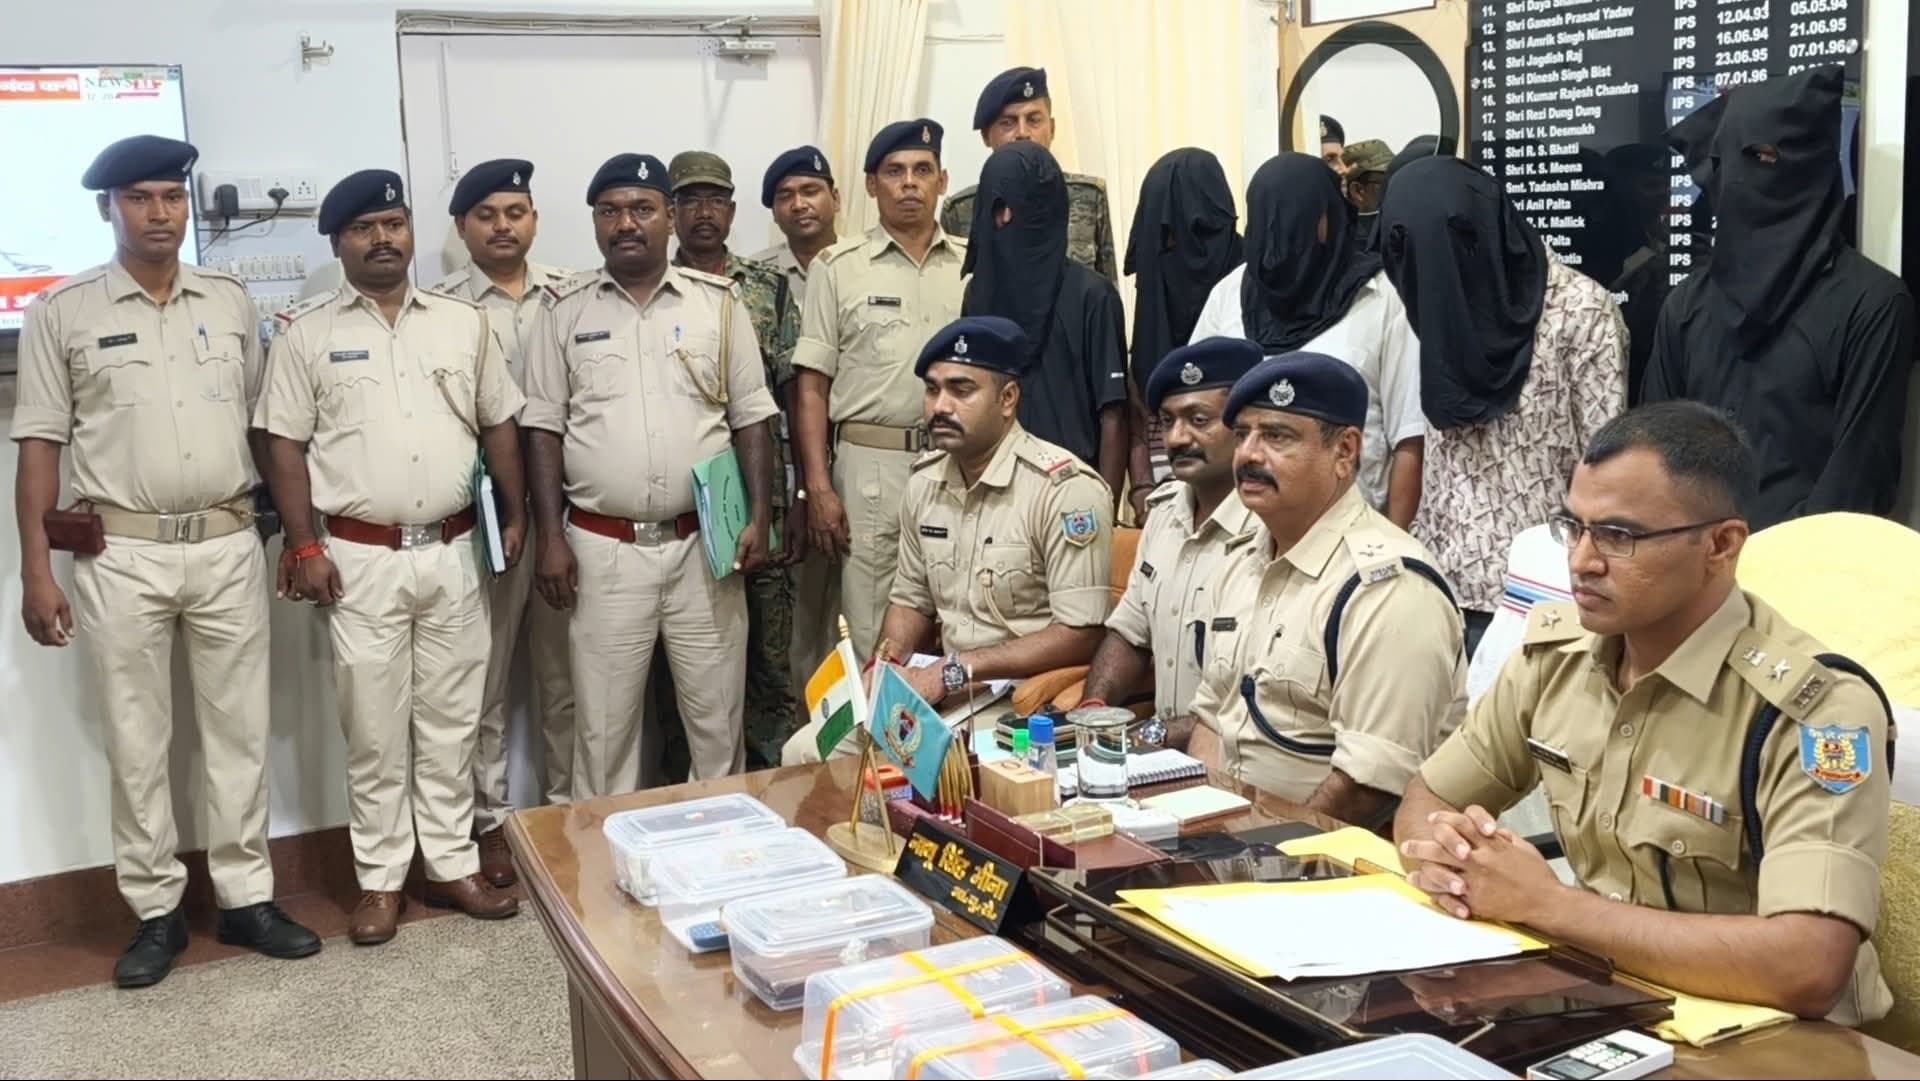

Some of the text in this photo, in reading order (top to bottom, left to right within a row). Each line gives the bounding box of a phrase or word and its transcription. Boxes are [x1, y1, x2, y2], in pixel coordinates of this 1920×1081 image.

[1482, 5, 1496, 17] 11.
[1506, 1, 1525, 14] Shri
[1527, 0, 1551, 13] Daya
[1482, 23, 1496, 35] 12.
[1506, 20, 1525, 32] Shri
[1527, 15, 1563, 30] Ganesh
[1565, 9, 1600, 24] Prasad
[1602, 6, 1634, 20] Yadav
[1482, 0, 1847, 53] 13. Shri Amrik Singh Nimbram IPS 12.04.93 05.05.94
[1482, 18, 1847, 71] 14. Shri Jagdish Raj IPS 16.06.94 21.06.95
[1482, 39, 1846, 89] 15. Shri Dinesh Singh Bist IPS 23.06.95 07.01.96
[1482, 68, 1768, 107] 16. Shri Kumar Rajesh Chandra IPS 07.01.96
[1482, 112, 1496, 124] 17.
[1506, 110, 1525, 123] Shri
[1549, 107, 1573, 120] Dung
[1575, 105, 1601, 119] Dung
[1672, 96, 1694, 109] IPS
[1482, 122, 1595, 142] 18. Shri V. H. Desmukh
[1482, 142, 1579, 159] 19. Shri R. S. Bhatti
[1505, 164, 1525, 176] Shri
[1526, 163, 1536, 175] K.
[1538, 163, 1548, 174] S.
[1550, 161, 1582, 173] Meena
[1671, 155, 1686, 168] IP
[1506, 174, 1693, 194] Smt. Tadasha Mishra IPS
[1526, 199, 1544, 211] Anil
[1546, 198, 1571, 210] Palta
[1670, 194, 1692, 207] IPS
[1538, 217, 1548, 228] K.
[1550, 216, 1585, 228] Mallick
[1670, 214, 1692, 227] IPS
[1546, 234, 1692, 246] Palta IPS
[1557, 253, 1692, 266] hatia IPS
